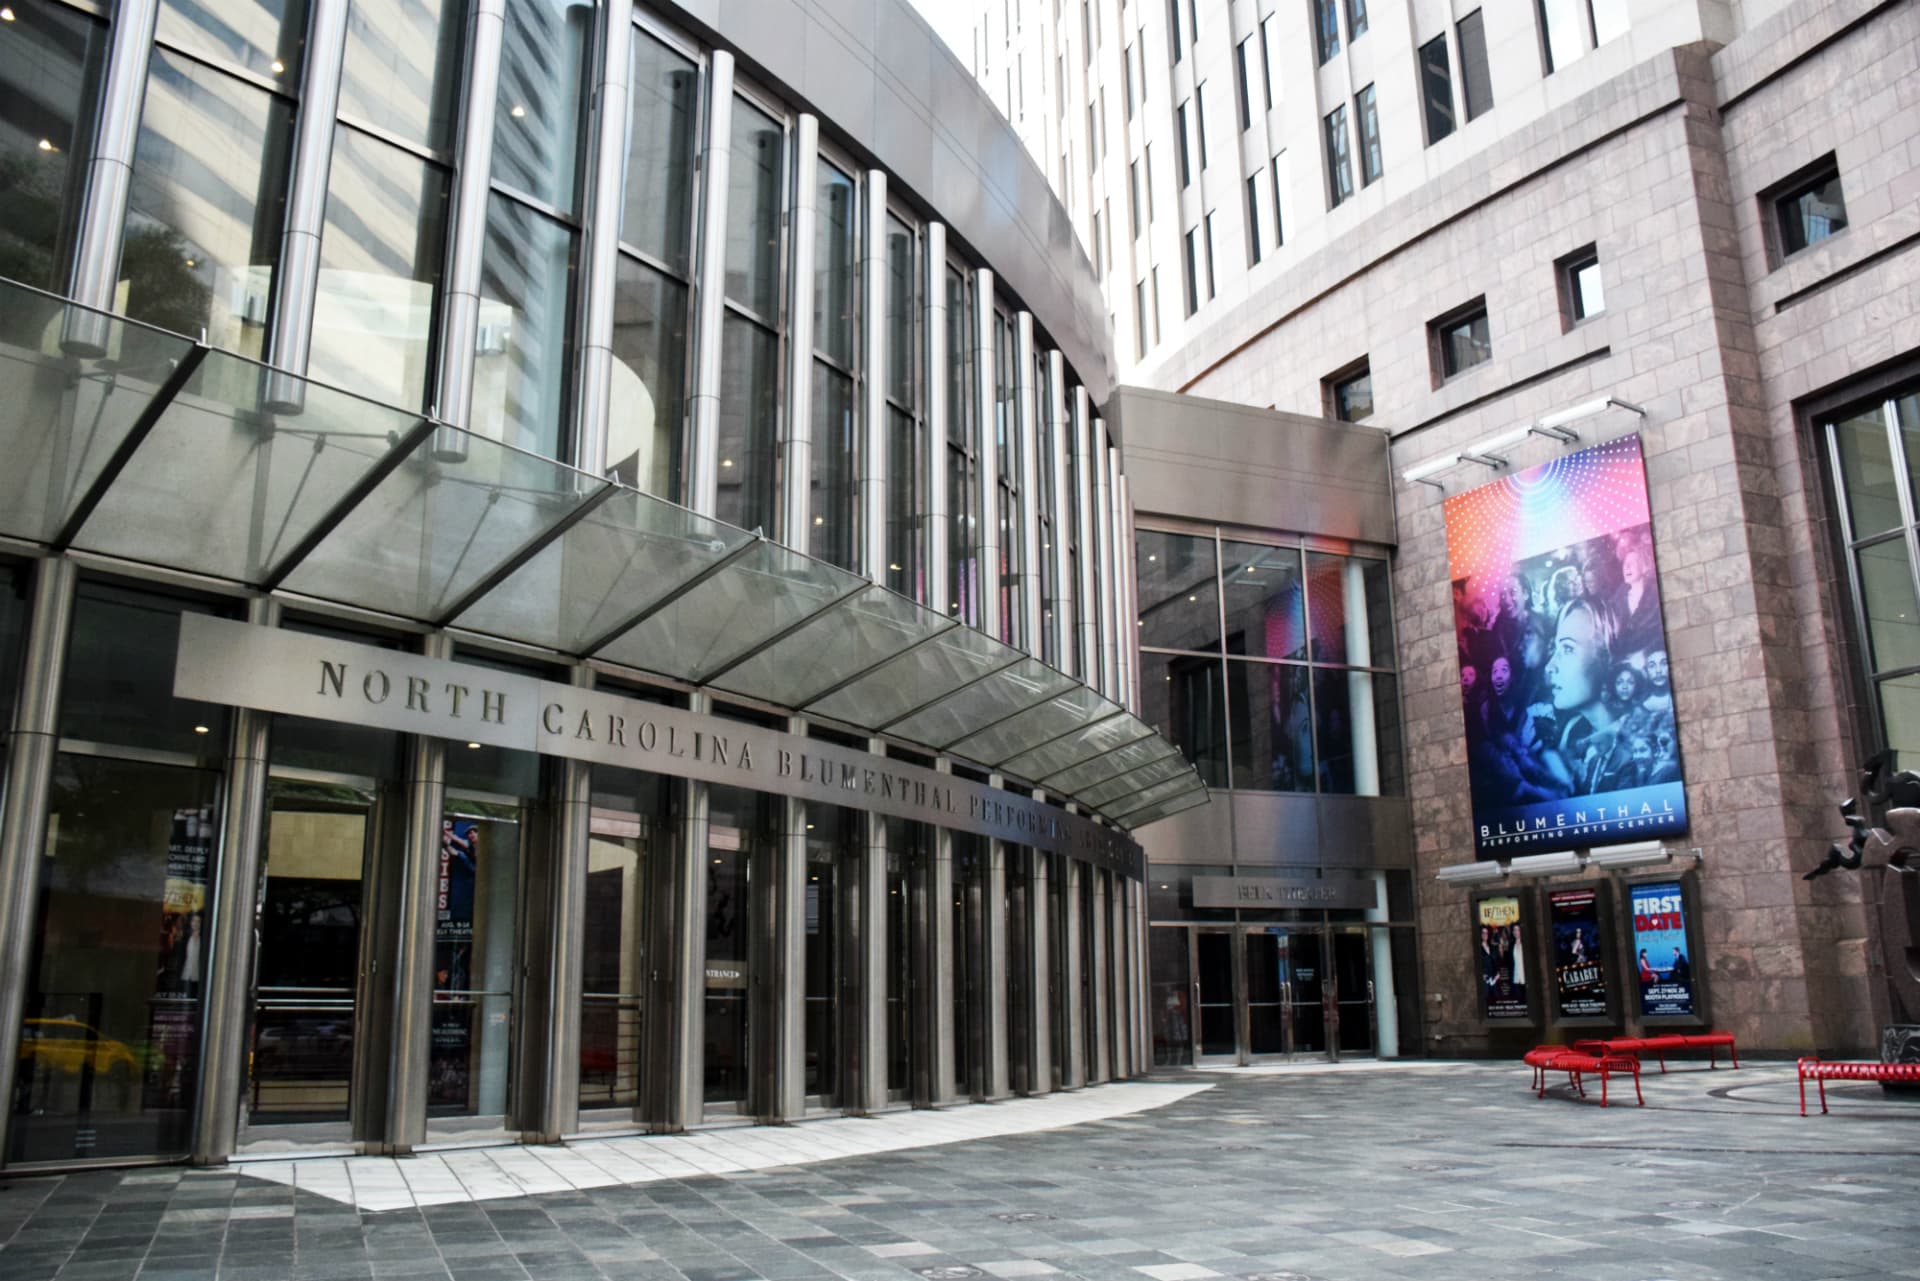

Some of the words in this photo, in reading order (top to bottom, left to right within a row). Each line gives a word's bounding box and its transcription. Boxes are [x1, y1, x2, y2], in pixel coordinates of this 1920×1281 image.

[317, 659, 507, 725] NORTH
[543, 703, 754, 770] CAROLINA
[778, 749, 958, 813] BLUMENTHAL
[1481, 799, 1674, 837] BLUMENTHAL
[1482, 829, 1564, 847] PERFORMING
[1573, 823, 1607, 835] ARTS
[1618, 814, 1675, 830] CENTER
[1633, 895, 1682, 915] FIRST
[1635, 912, 1683, 933] DATE
[1563, 967, 1599, 985] CABARET
